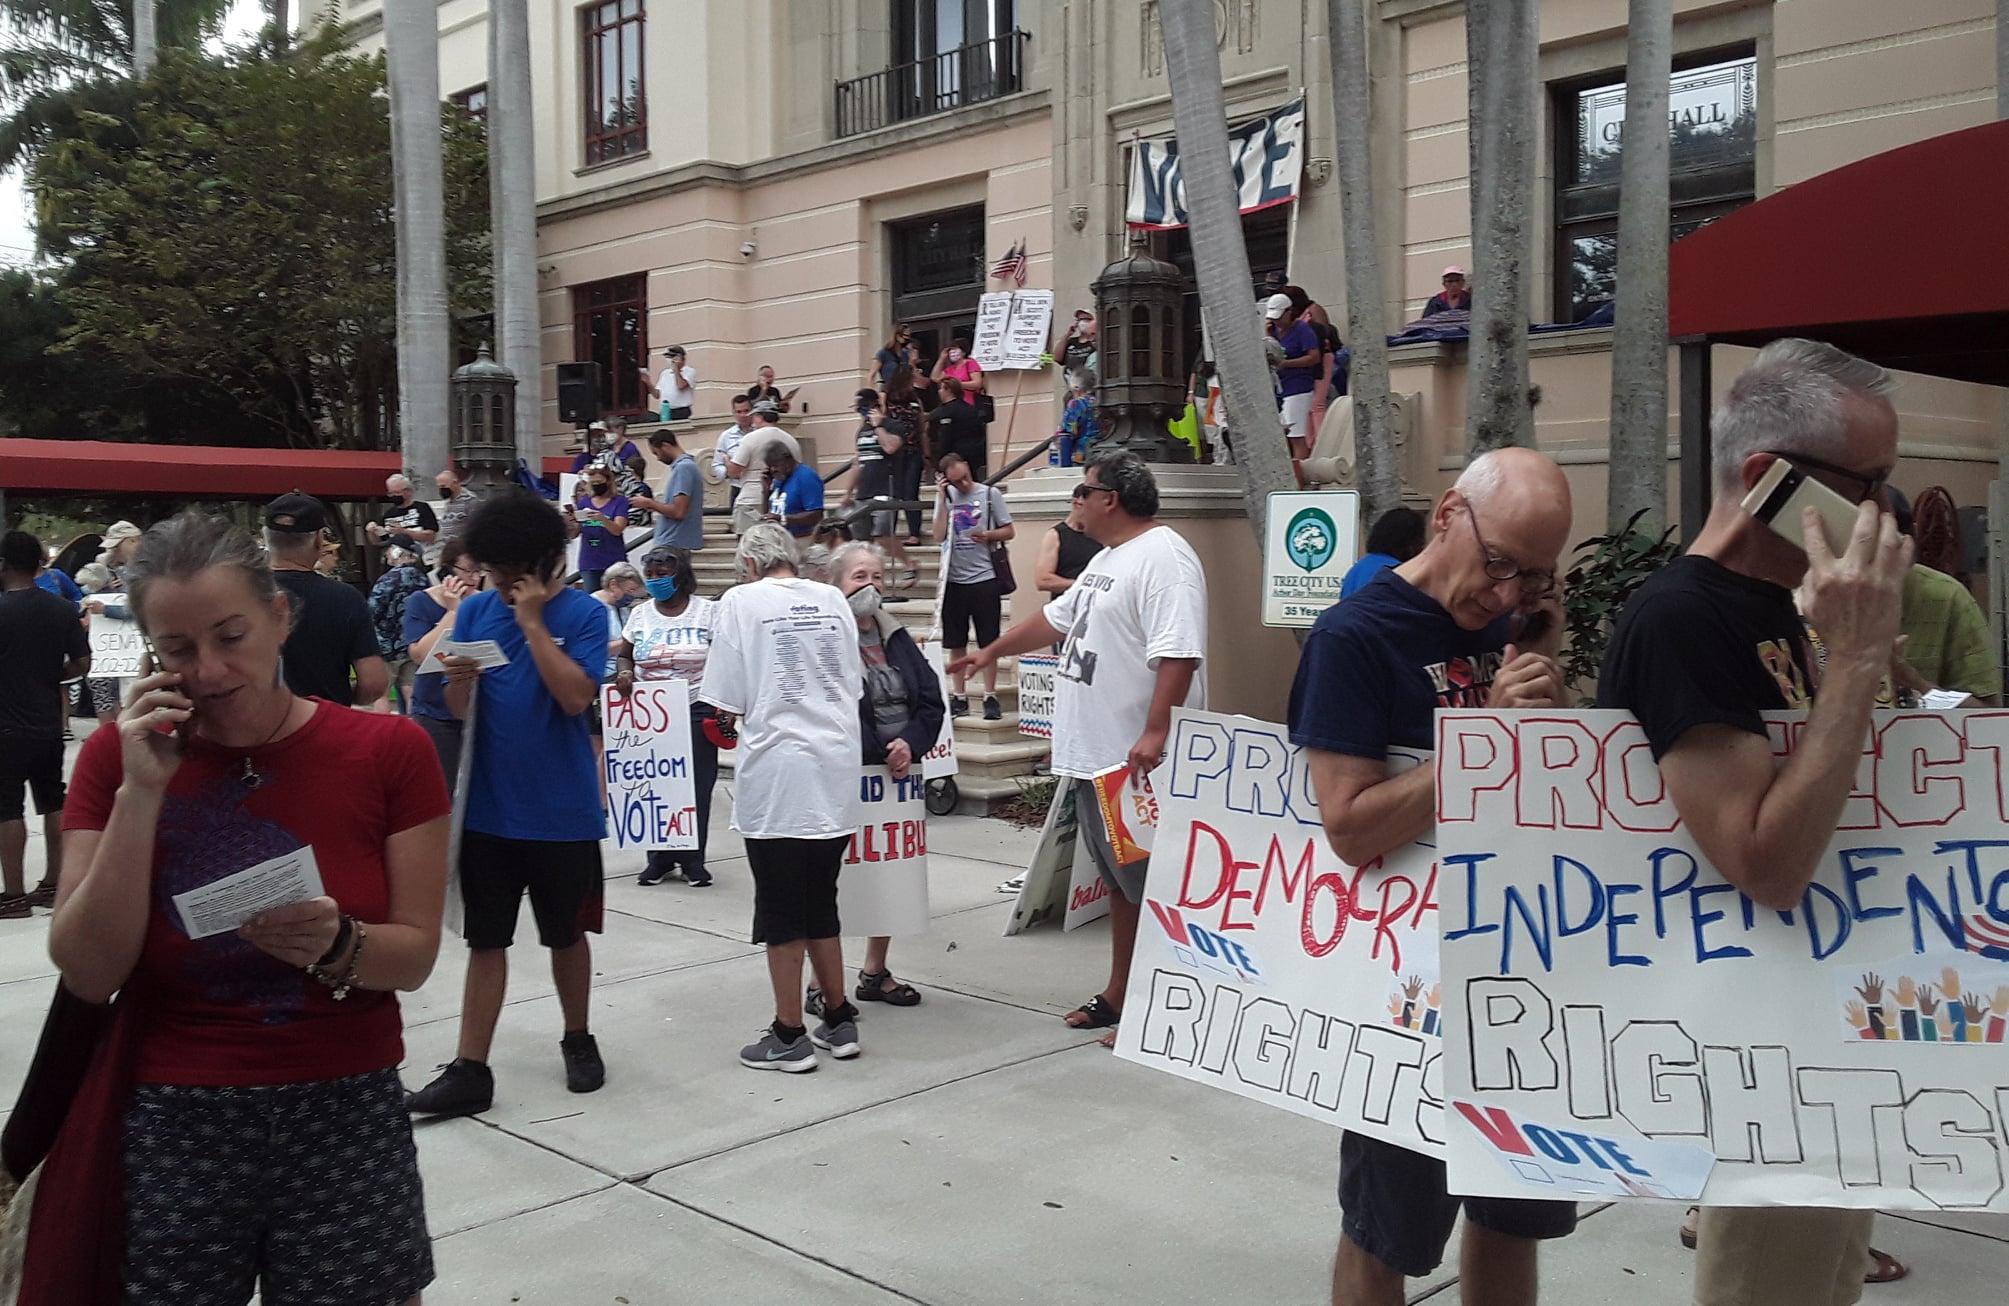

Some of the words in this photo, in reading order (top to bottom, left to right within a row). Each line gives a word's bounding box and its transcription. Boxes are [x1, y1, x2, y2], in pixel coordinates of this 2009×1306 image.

[1669, 102, 1726, 129] HALL
[1272, 575, 1299, 587] TREE
[1300, 575, 1324, 591] CITY
[1326, 576, 1344, 588] US
[1284, 606, 1297, 616] 35
[90, 656, 140, 674] 202-22
[1020, 672, 1054, 692] VOTING
[606, 685, 670, 733] PASS
[612, 730, 654, 749] the
[1436, 713, 2009, 833] PROC
[620, 780, 651, 799] to
[892, 773, 925, 803] TH
[608, 790, 669, 849] VOTE
[665, 807, 697, 837] ACT
[1132, 794, 1153, 827] ACT
[1146, 898, 1260, 977] VOTE
[1453, 1100, 1652, 1178] VOTE
